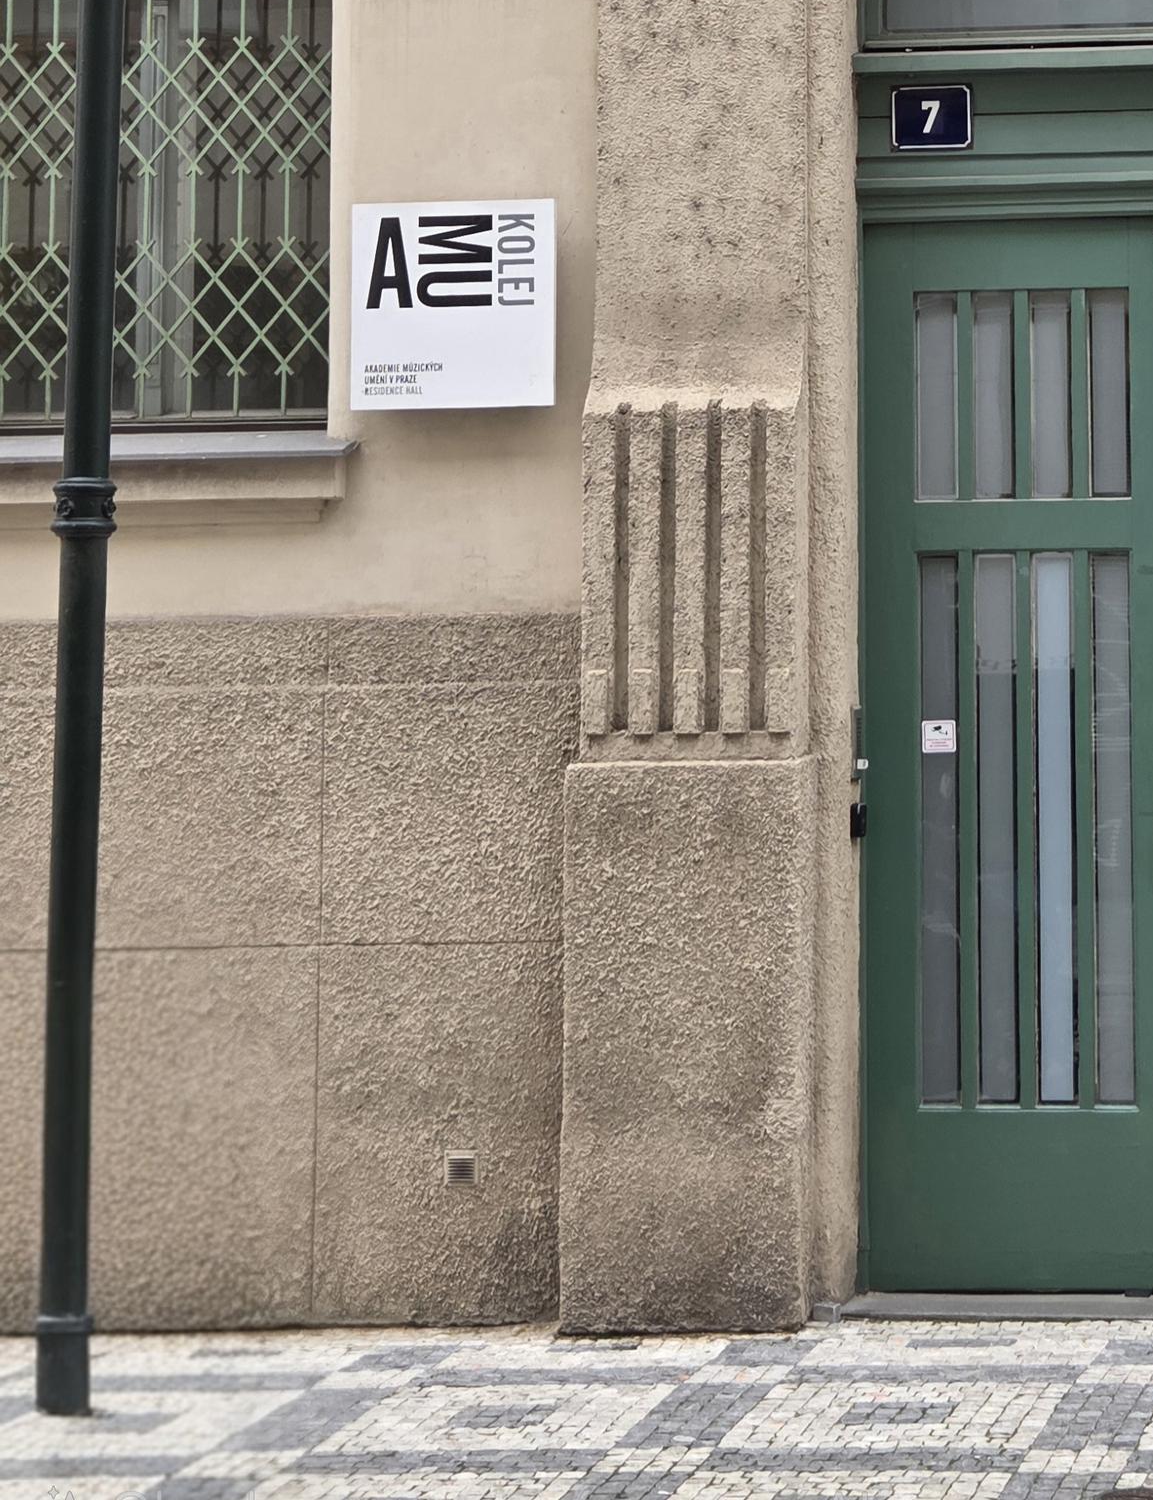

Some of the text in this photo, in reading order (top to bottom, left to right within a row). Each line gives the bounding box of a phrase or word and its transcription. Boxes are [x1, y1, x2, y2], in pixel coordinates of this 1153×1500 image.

[921, 100, 940, 134] 7
[366, 214, 493, 309] AMU
[497, 213, 535, 306] KOLEJ
[364, 361, 443, 373] AKADEMIE MÚZICKÝCH
[364, 374, 417, 385] UMĚNÍ V PRAZE
[364, 385, 423, 396] RESIDENCE HALL
